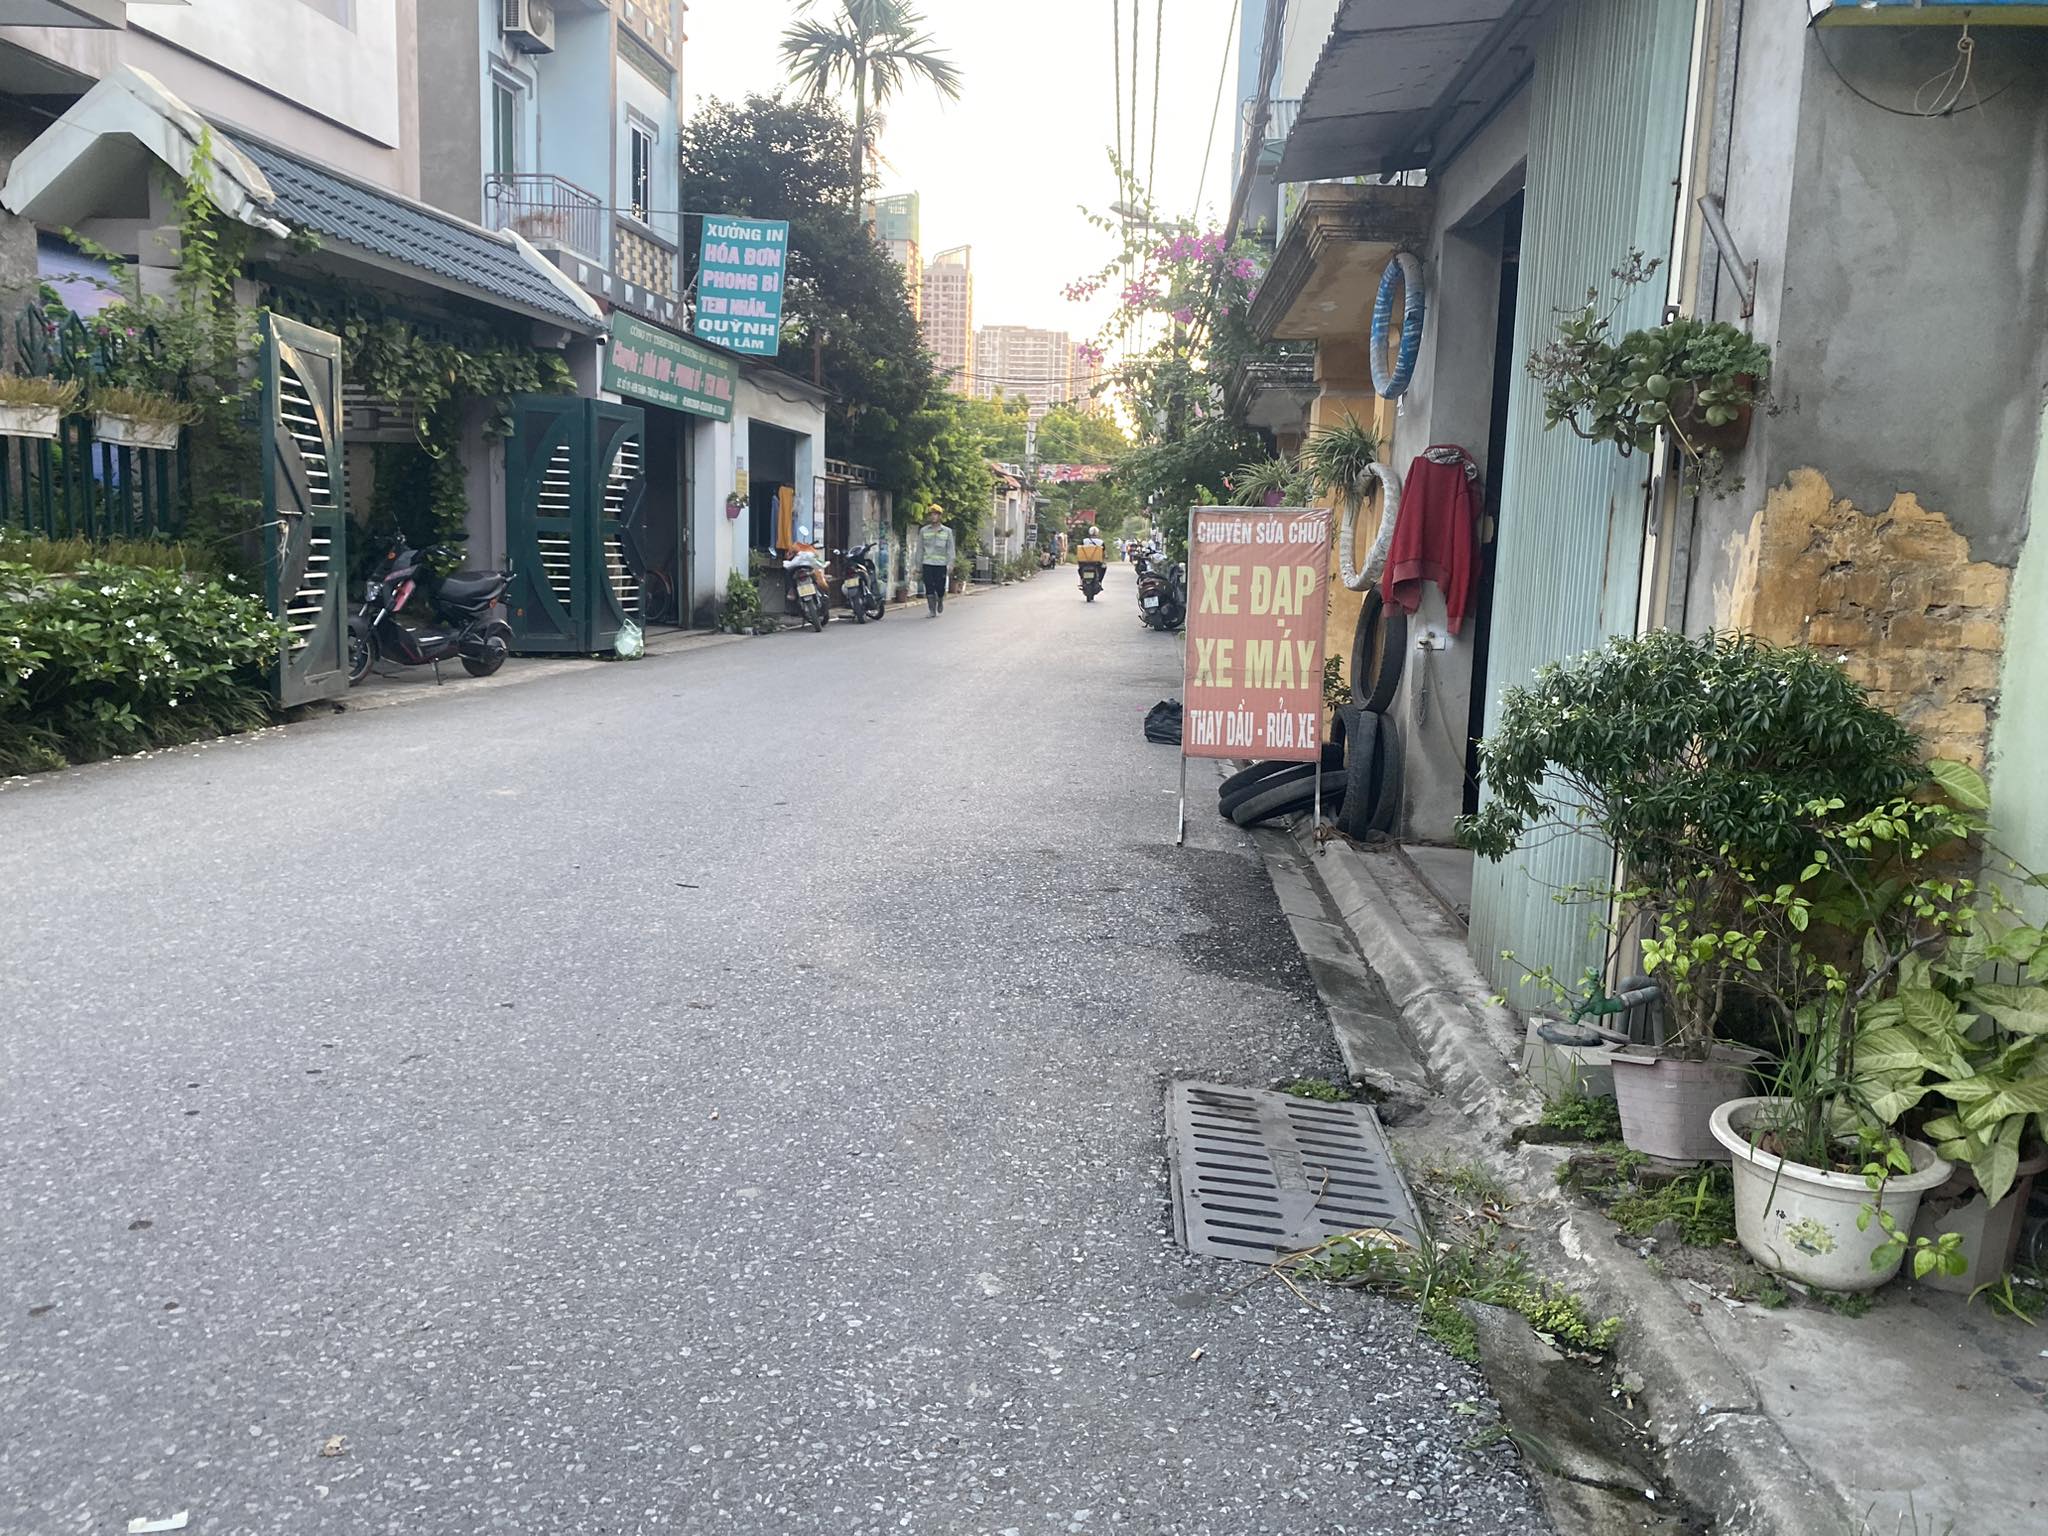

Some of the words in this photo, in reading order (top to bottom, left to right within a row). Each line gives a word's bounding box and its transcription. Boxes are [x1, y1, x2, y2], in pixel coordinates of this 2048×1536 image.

[707, 222, 762, 241] XƯỞNG
[766, 229, 784, 242] IN
[704, 242, 740, 265] HÓA
[744, 247, 781, 267] ĐƠN
[702, 269, 758, 292] PHONG
[762, 272, 779, 292] BÌ
[734, 337, 764, 350] LÂM
[1197, 518, 1252, 545] CHUYÊN
[1256, 513, 1284, 545] SỬA
[1199, 564, 1241, 615] XE
[1250, 565, 1316, 628] ĐẠP
[1193, 637, 1234, 688] XE
[1244, 628, 1317, 690] MÁY
[1190, 709, 1224, 746] THAY
[1226, 698, 1254, 747] DẦU
[1266, 696, 1294, 748] RỬA
[1297, 713, 1316, 748] XE
